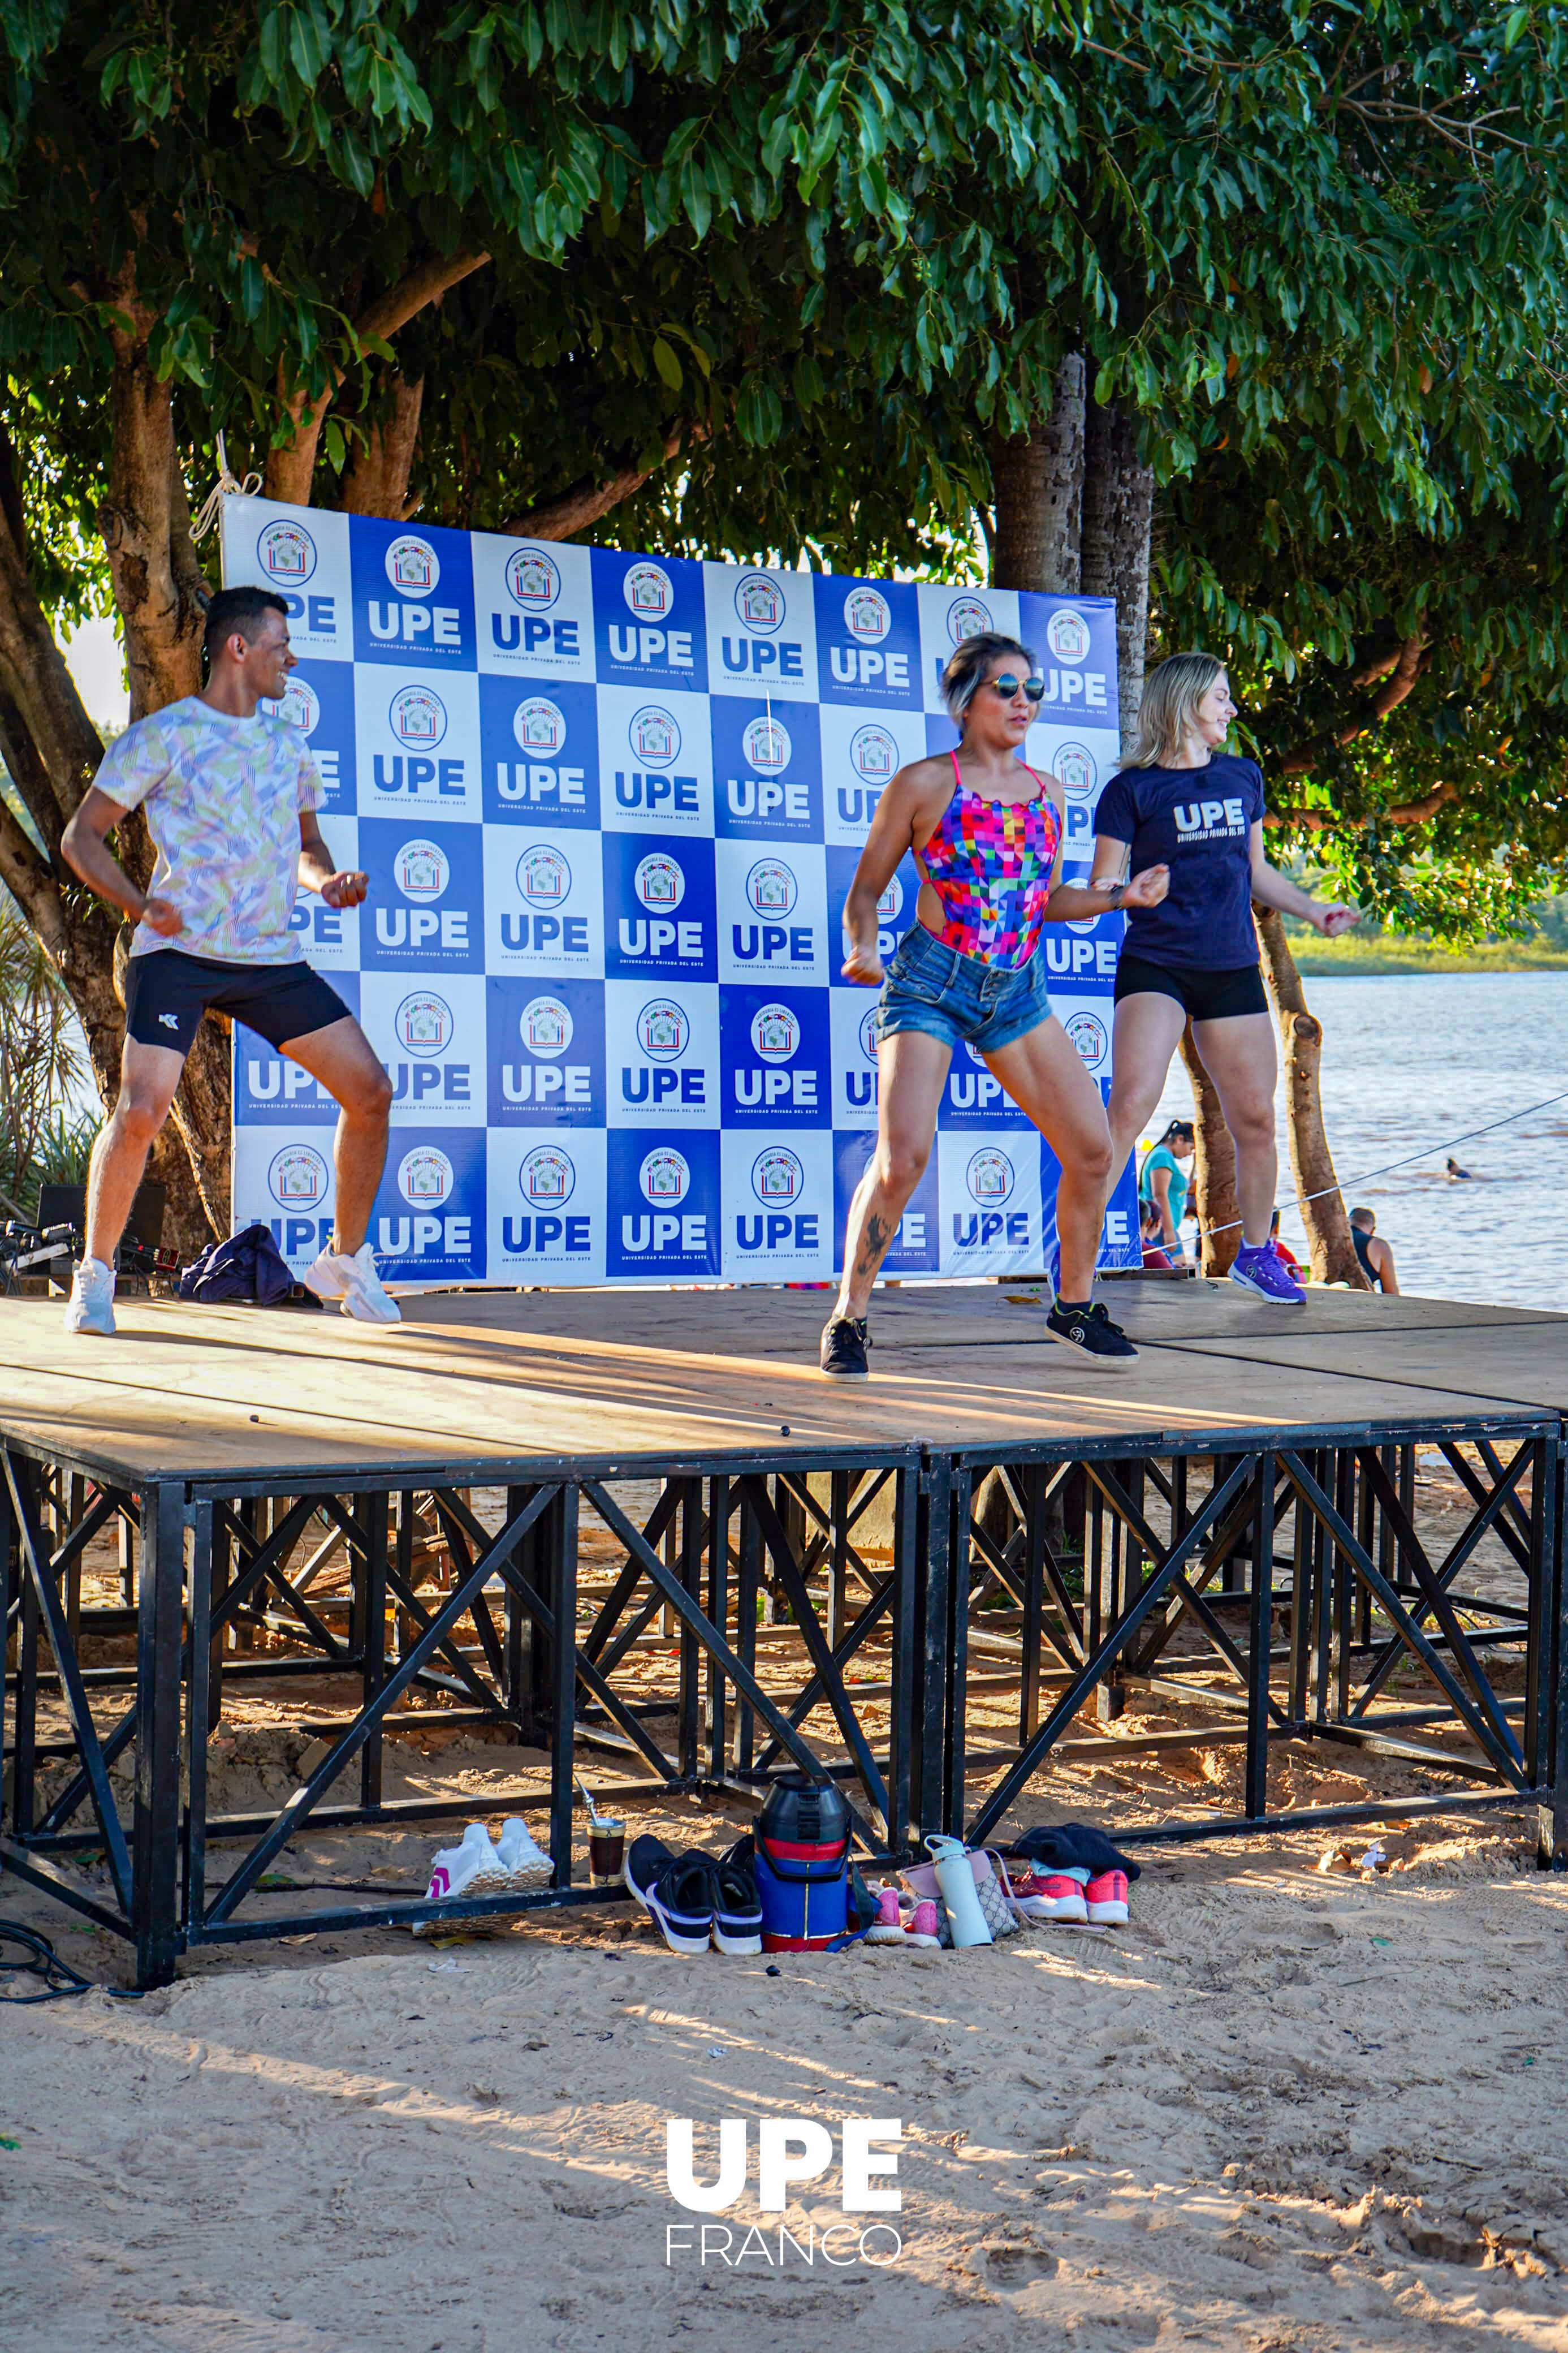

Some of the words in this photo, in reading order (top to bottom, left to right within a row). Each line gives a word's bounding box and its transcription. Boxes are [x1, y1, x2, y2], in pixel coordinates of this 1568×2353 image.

[369, 601, 460, 645] UPE
[493, 613, 579, 656] UPE
[609, 624, 693, 667] UPE
[722, 636, 802, 677] UPE
[831, 647, 909, 688] UPE
[1037, 667, 1107, 706] UPE
[374, 755, 465, 796] UPE
[498, 762, 585, 804] UPE
[615, 772, 698, 812] UPE
[728, 780, 810, 820] UPE
[1173, 798, 1244, 832] UPE
[376, 908, 468, 949] UPE
[501, 913, 588, 953] UPE
[619, 919, 703, 958] UPE
[733, 924, 813, 961] UPE
[1047, 938, 1117, 974] UPE
[502, 1065, 591, 1102] UPE
[622, 1067, 705, 1104] UPE
[735, 1070, 817, 1105] UPE
[379, 1216, 472, 1255] UPE
[503, 1216, 590, 1253] UPE
[622, 1214, 707, 1252] UPE
[737, 1214, 818, 1249] UPE
[953, 1212, 1029, 1247] UPE
